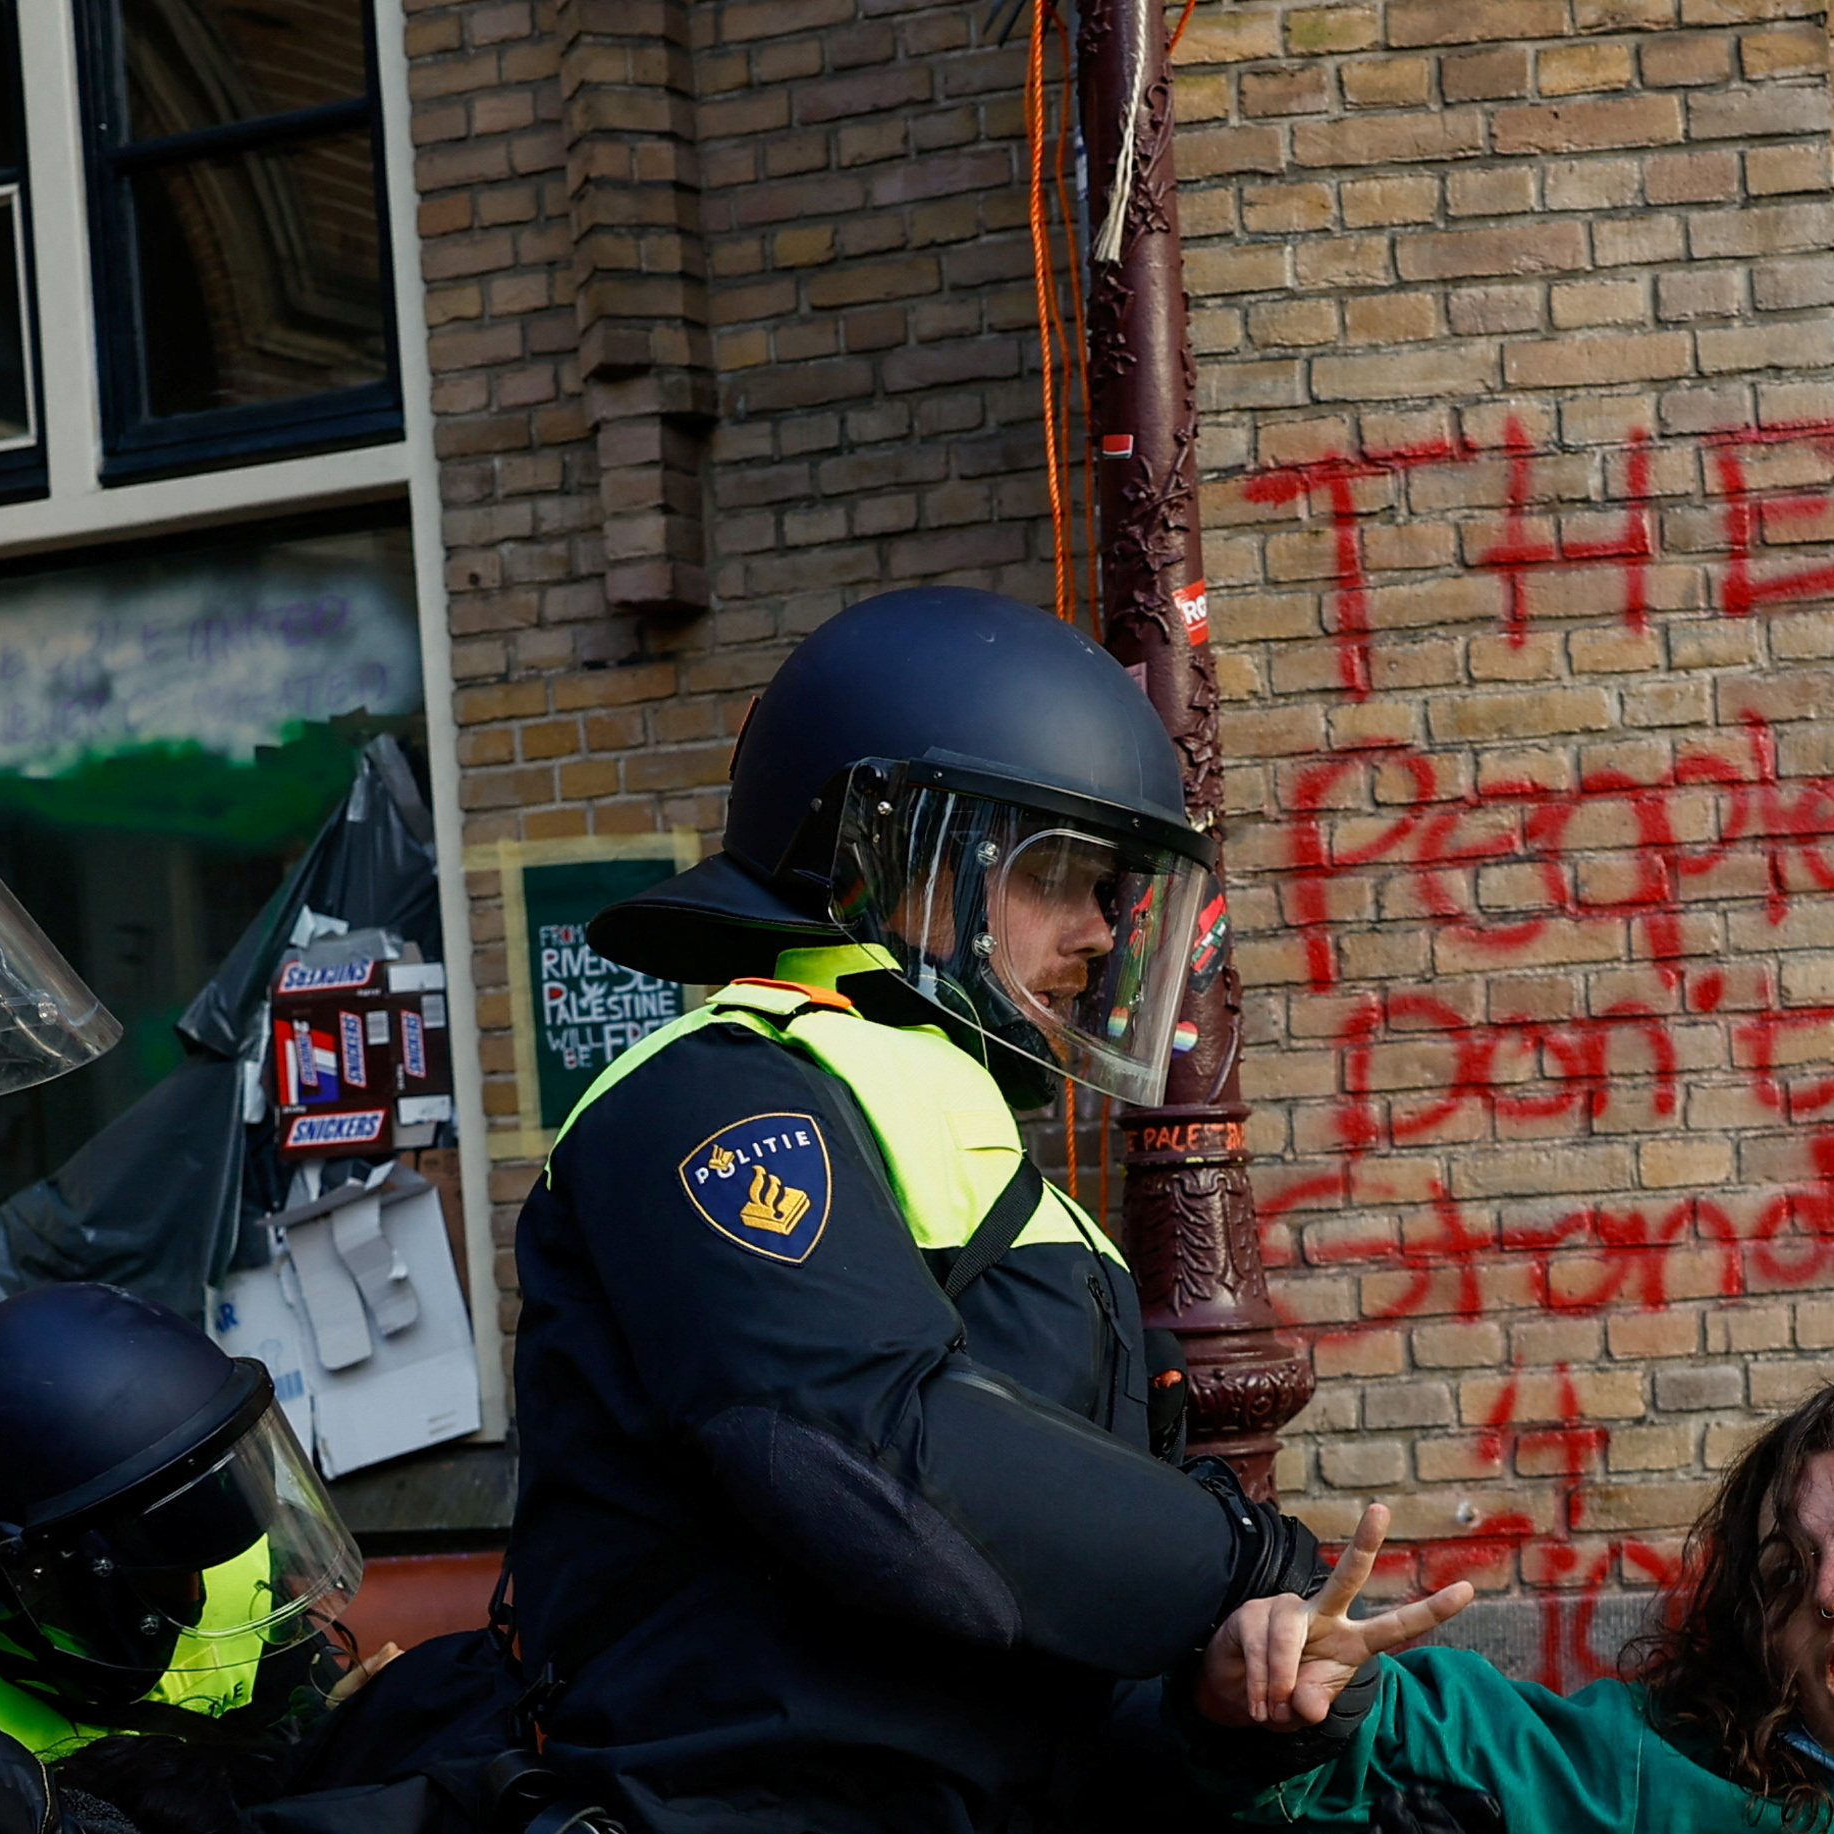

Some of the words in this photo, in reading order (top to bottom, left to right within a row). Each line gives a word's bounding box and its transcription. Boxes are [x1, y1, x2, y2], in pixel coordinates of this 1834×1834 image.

[539, 924, 585, 948] FROM
[542, 981, 677, 1026] PALESTINE
[342, 1011, 364, 1084] SNICKERS
[563, 1046, 593, 1070] BE
[292, 1113, 380, 1144] SNICKERS
[695, 1129, 812, 1186] POLITIE
